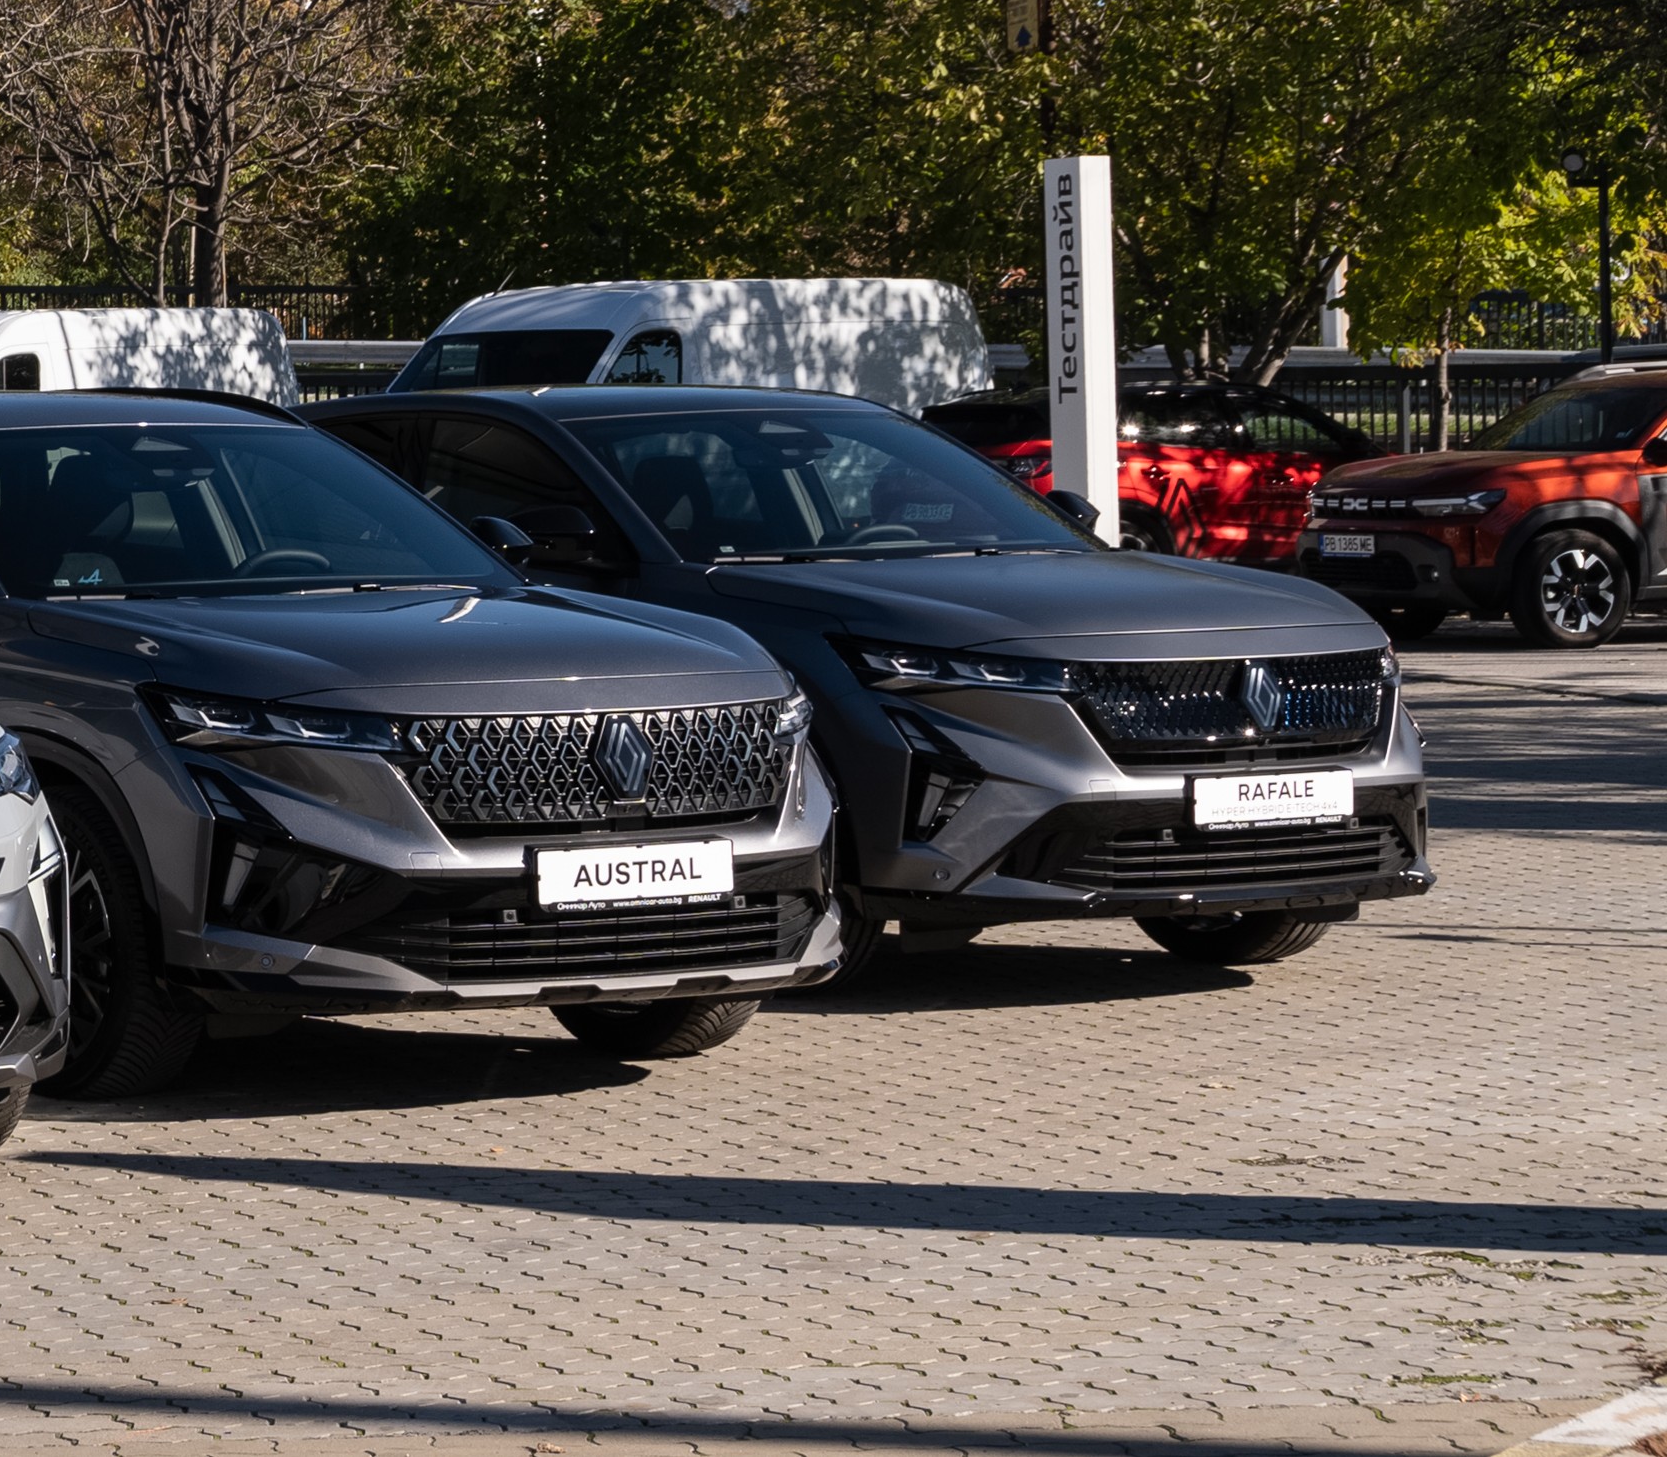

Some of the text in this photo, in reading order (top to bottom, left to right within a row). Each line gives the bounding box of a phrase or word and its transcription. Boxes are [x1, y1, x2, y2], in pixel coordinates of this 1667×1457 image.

[1052, 173, 1080, 405] Тестдрайв
[1238, 780, 1314, 801] RAFALE
[573, 857, 702, 888] AUSTRAL
[613, 896, 682, 907] www.omnicar-auto.bg
[688, 893, 721, 903] RENAULT
